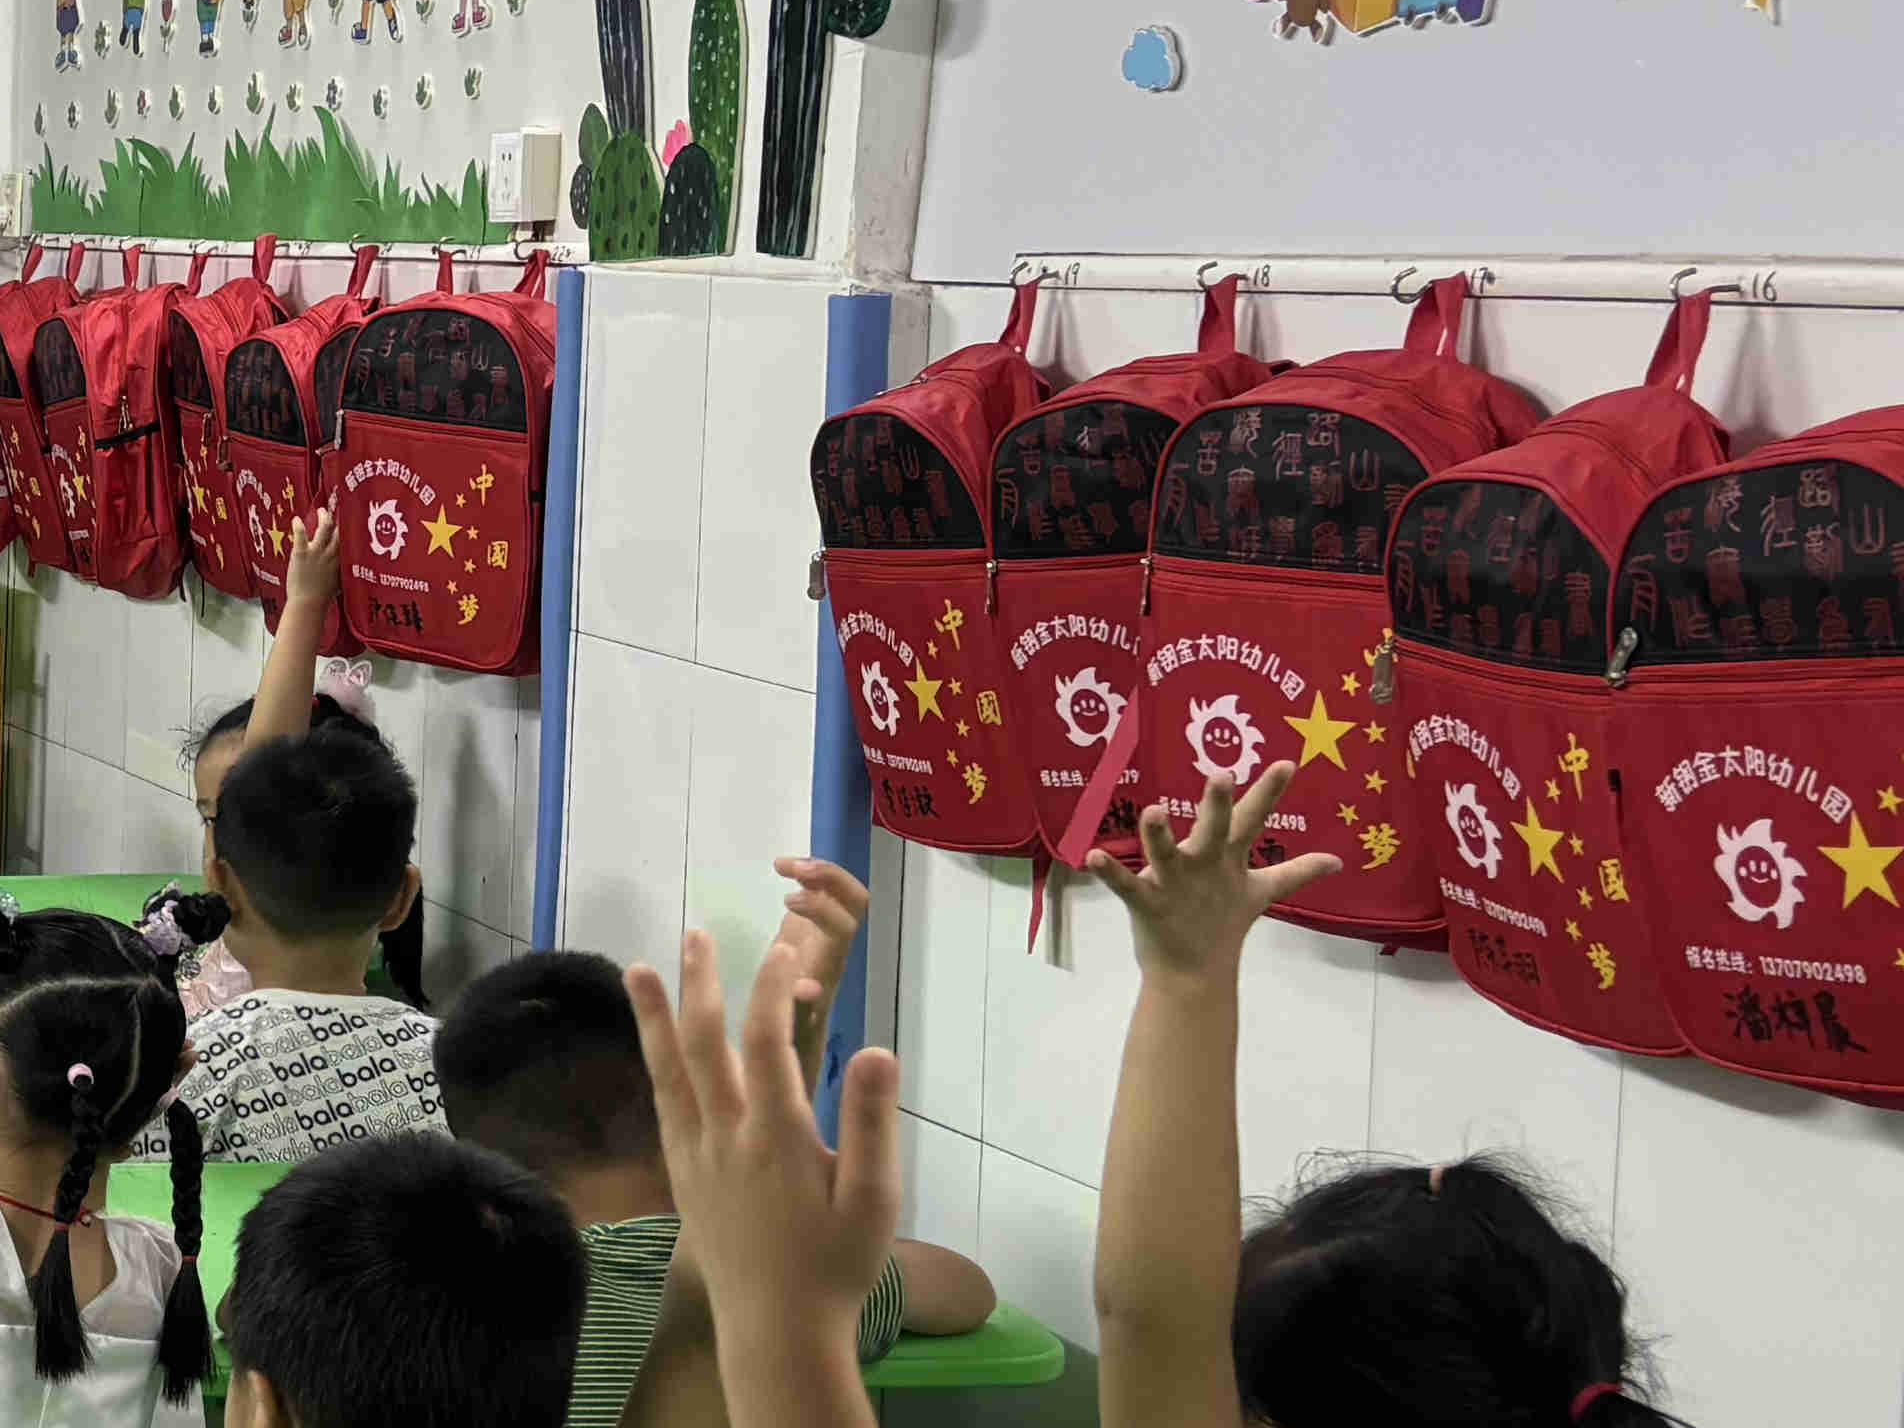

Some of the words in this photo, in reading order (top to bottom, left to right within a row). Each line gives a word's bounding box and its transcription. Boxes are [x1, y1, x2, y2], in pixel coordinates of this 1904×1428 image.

[1064, 262, 1080, 286] 19
[1254, 264, 1271, 287] 18
[1752, 271, 1778, 302] 16
[1010, 613, 1141, 671] 新钢金太阳幼儿
[1146, 633, 1305, 701] 新钢金太阳幼儿园
[1654, 745, 1853, 824] 新钢金太阳幼儿园
[1759, 955, 1867, 985] 13707902498
[208, 1045, 259, 1081] bala
[308, 1013, 368, 1042] bala
[269, 1052, 328, 1081] bala
[377, 1019, 430, 1047] bala
[231, 1089, 287, 1119] bala
[337, 1056, 397, 1088] bala
[294, 1100, 354, 1131] bala
